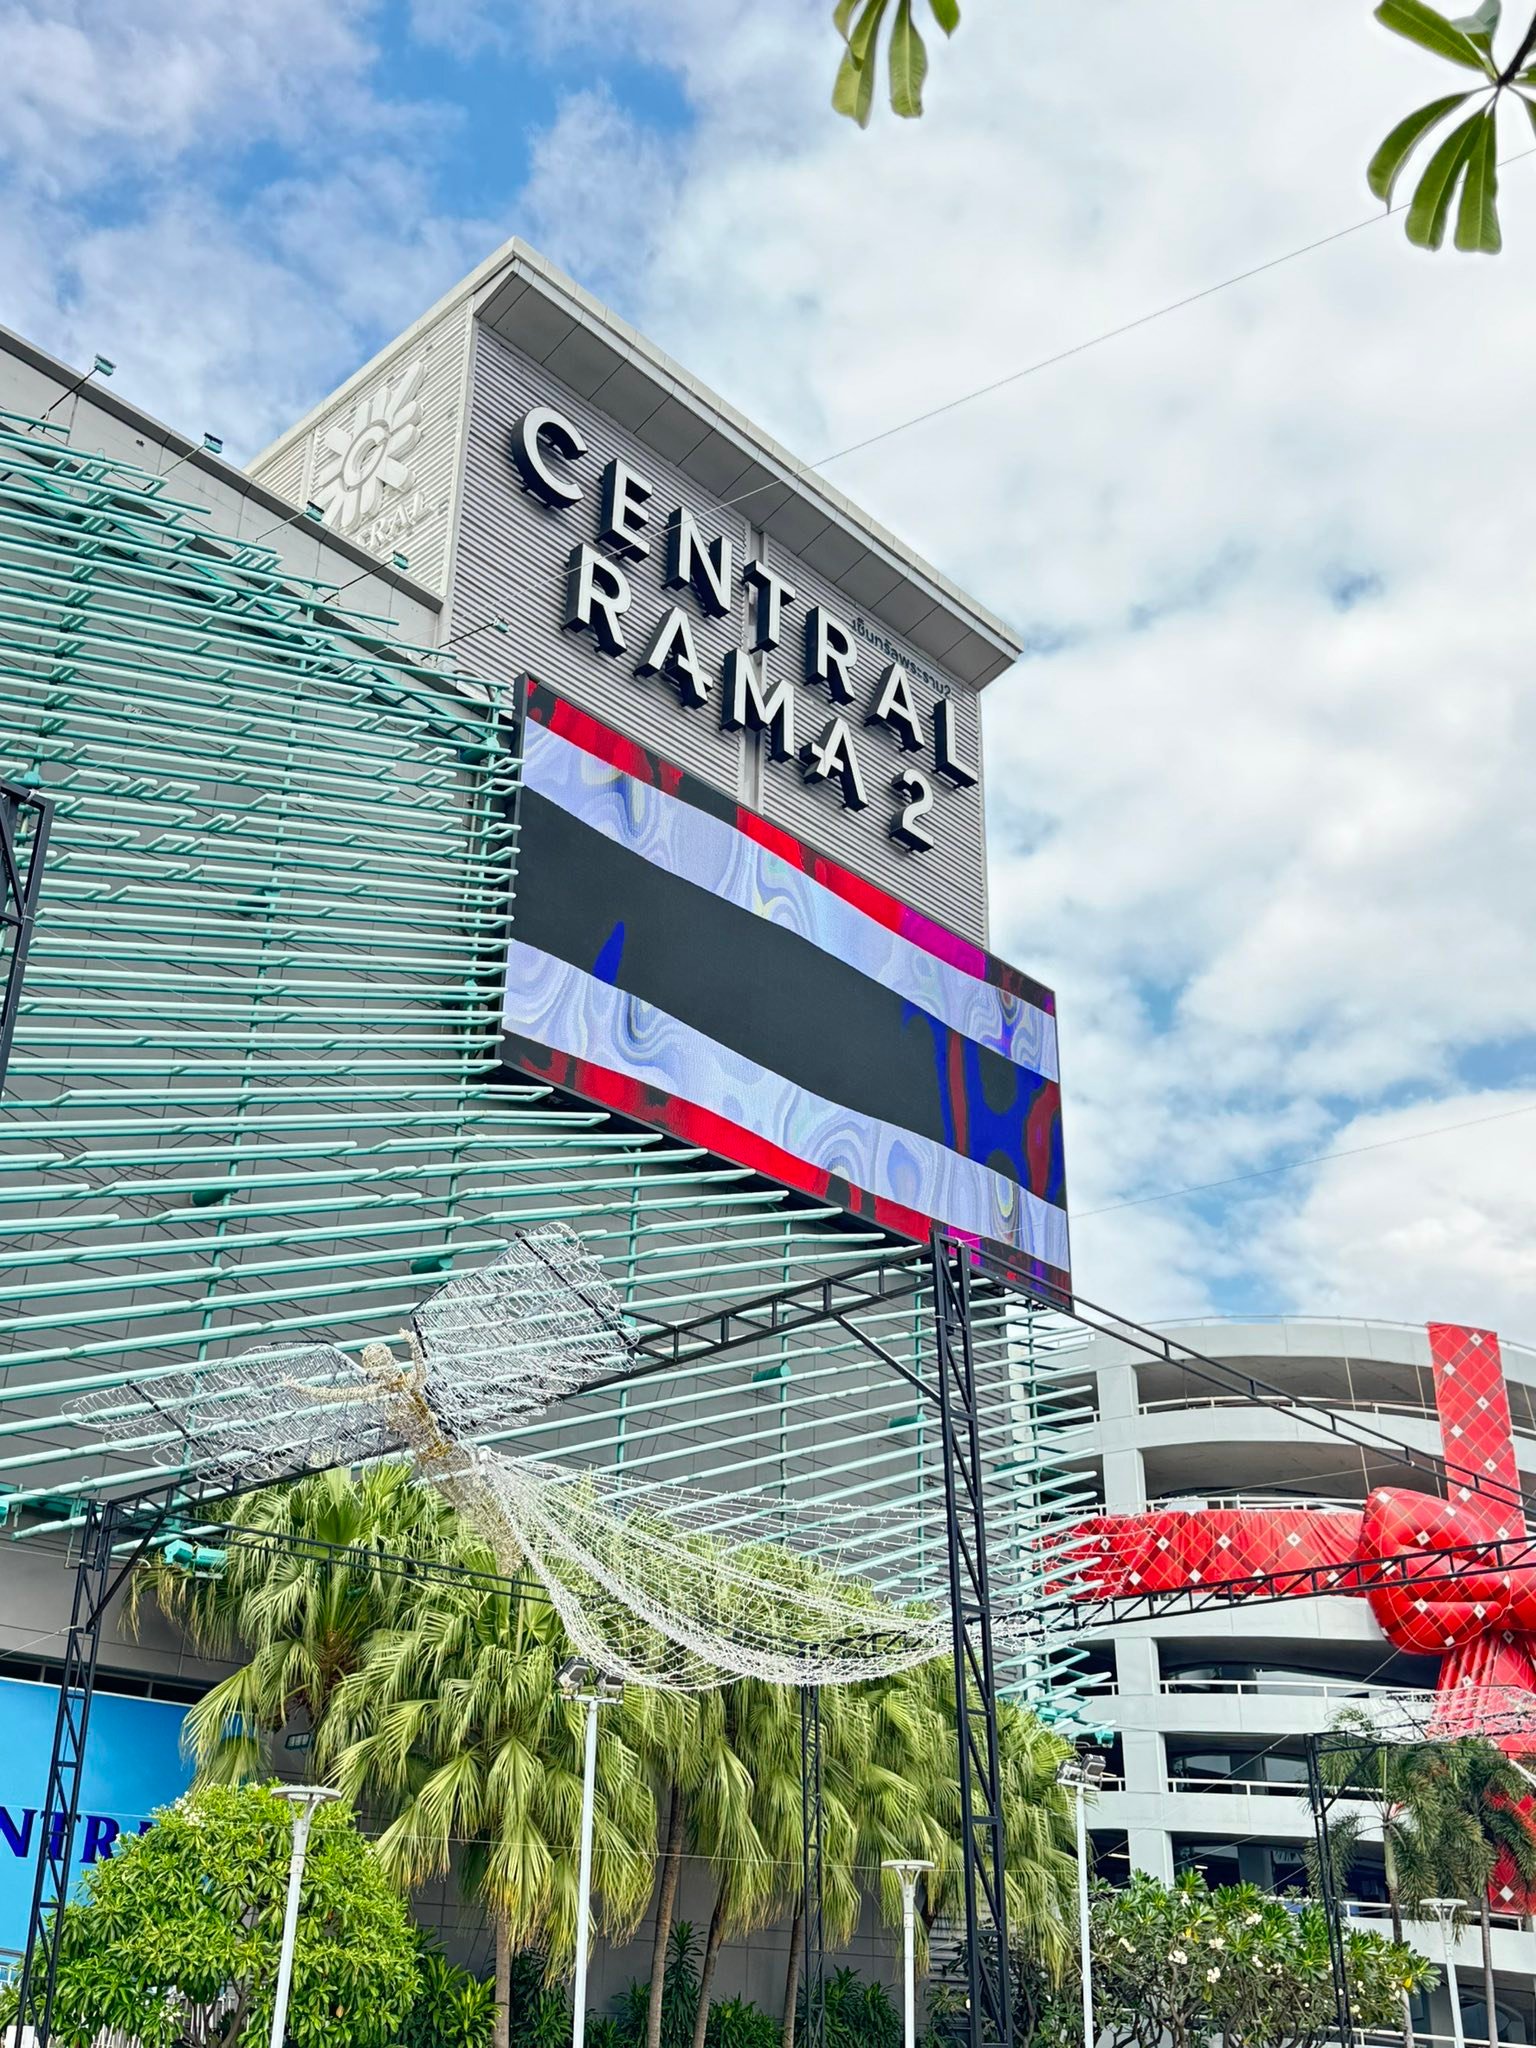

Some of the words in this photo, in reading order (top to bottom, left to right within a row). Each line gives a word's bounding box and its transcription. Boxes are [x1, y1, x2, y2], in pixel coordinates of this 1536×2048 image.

[511, 406, 978, 789] CENTRAL
[561, 542, 869, 812] RAMA
[889, 768, 934, 853] 2
